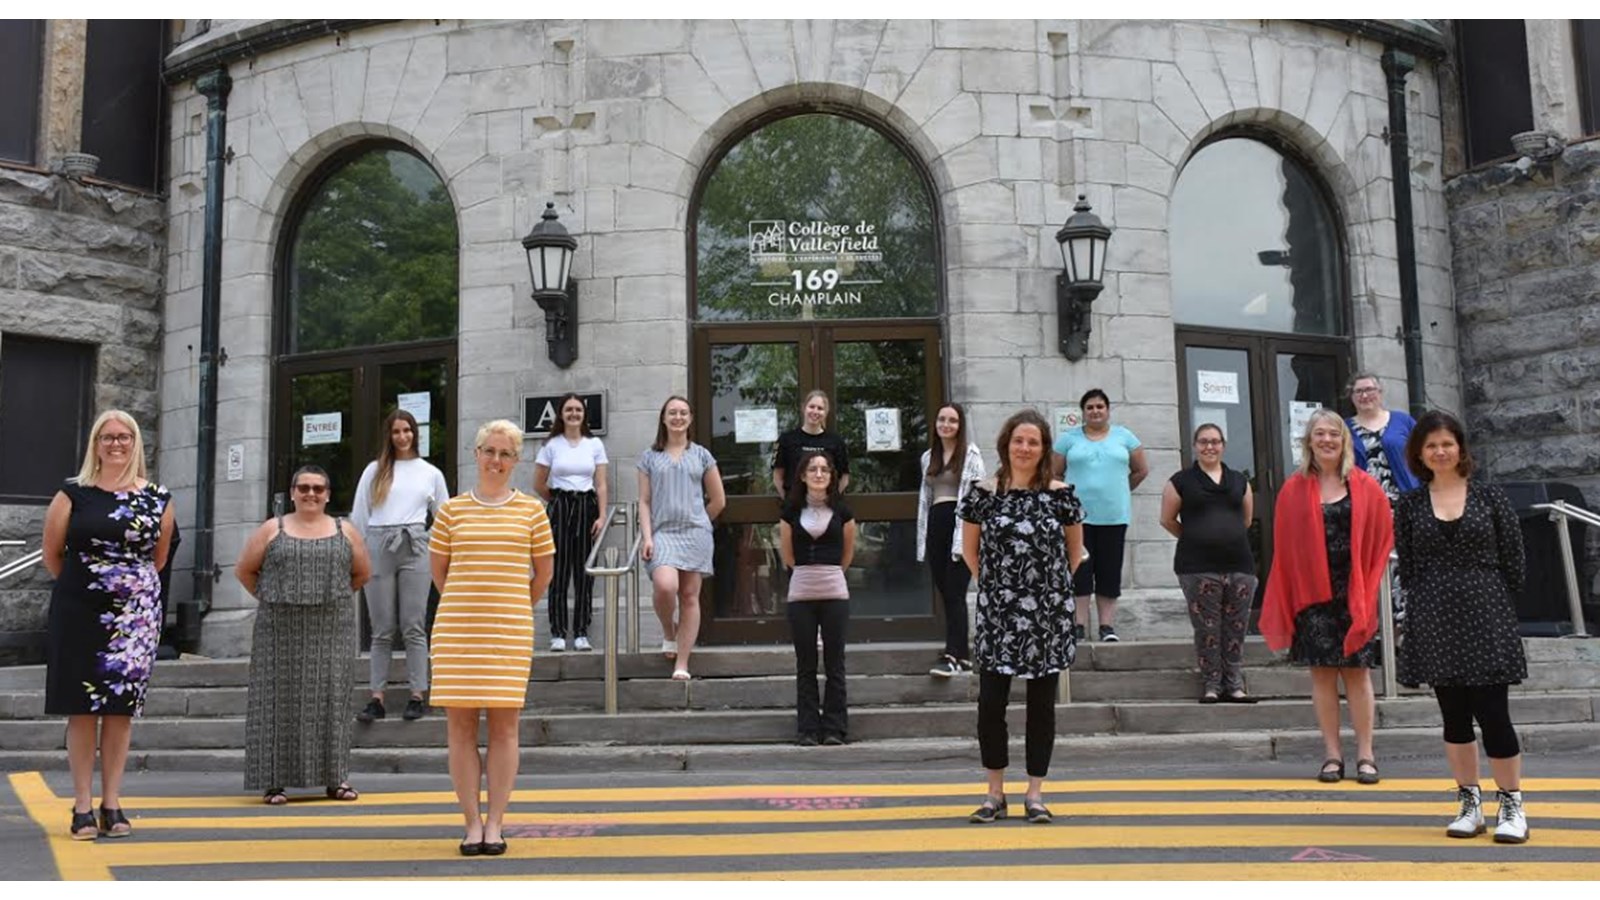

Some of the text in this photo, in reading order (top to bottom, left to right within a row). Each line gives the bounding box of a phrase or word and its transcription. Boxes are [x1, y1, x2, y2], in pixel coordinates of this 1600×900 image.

[788, 220, 875, 238] Collège de
[788, 236, 879, 254] Valleyfield
[792, 269, 839, 291] 169
[768, 292, 862, 306] CHAMPLAIN
[306, 421, 338, 432] ENTRÉE
